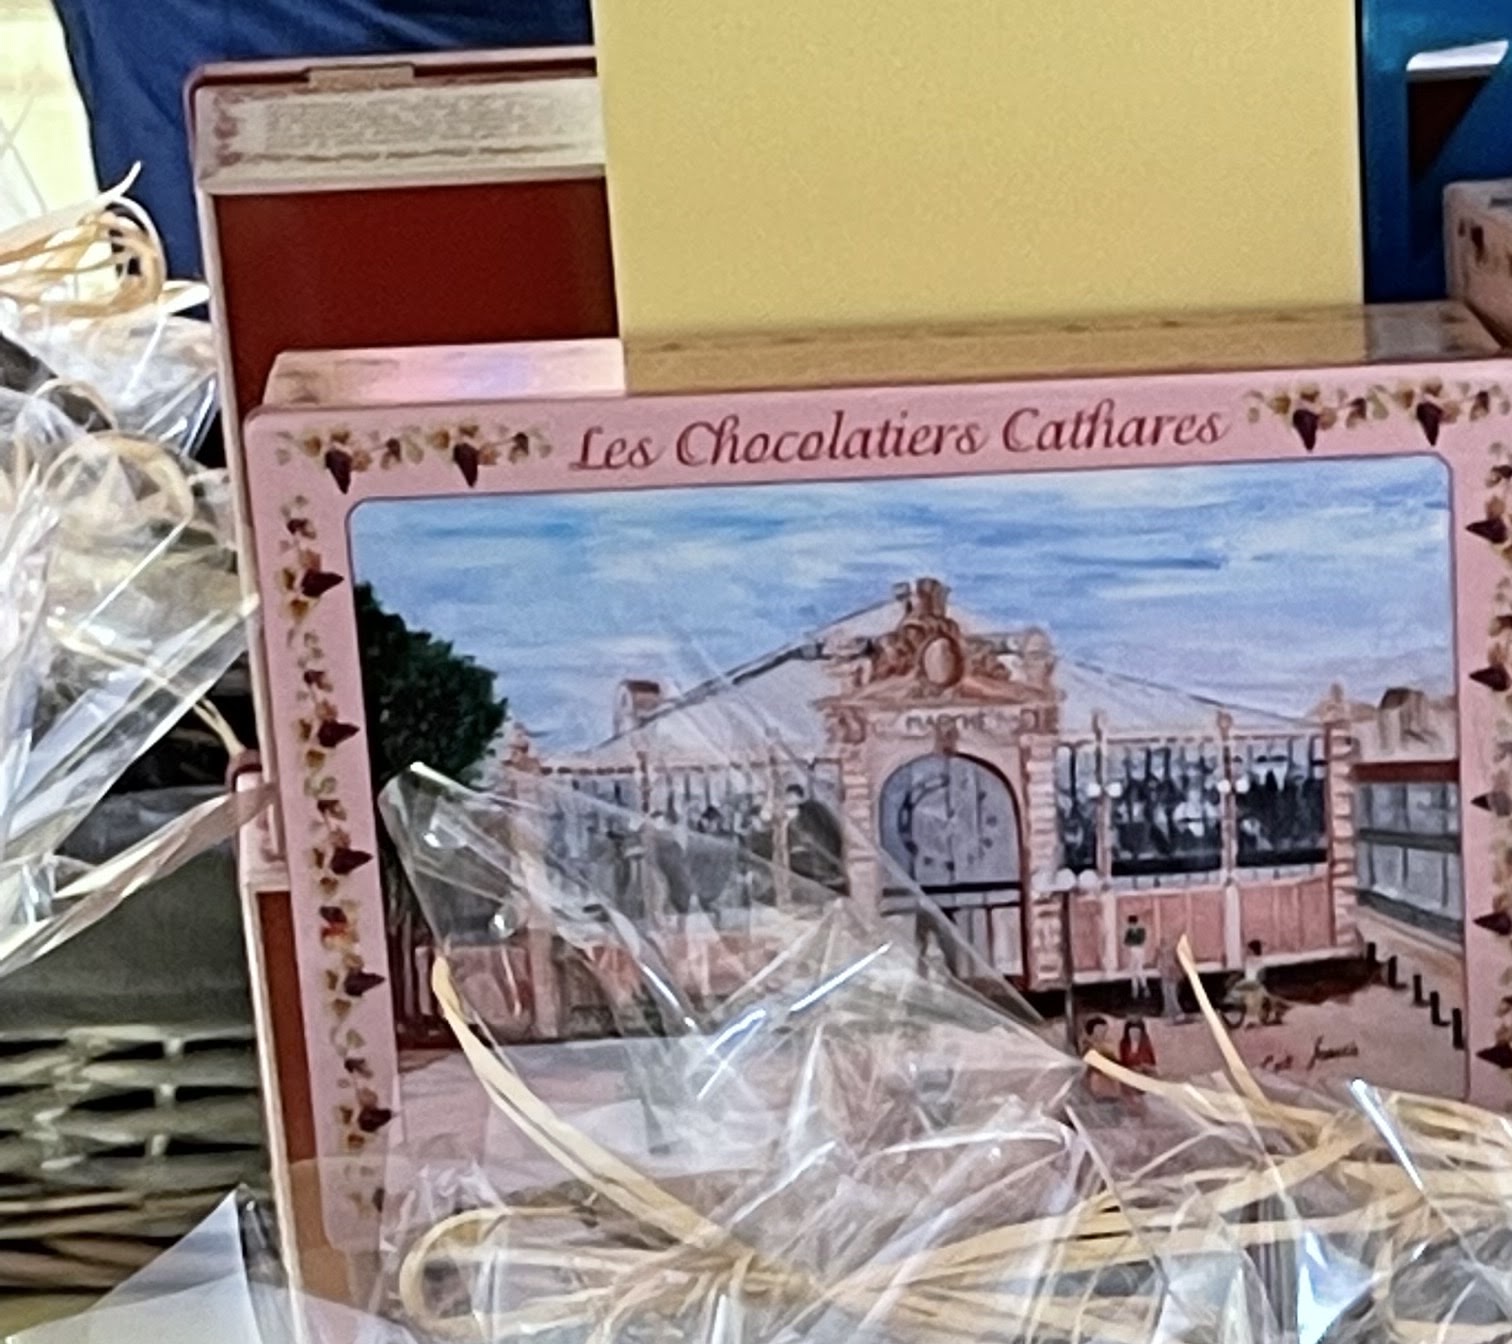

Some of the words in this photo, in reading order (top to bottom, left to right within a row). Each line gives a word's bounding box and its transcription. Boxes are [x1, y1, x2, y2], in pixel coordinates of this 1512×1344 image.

[568, 426, 662, 472] Les
[676, 409, 991, 467] Chocolatiers
[1002, 398, 1233, 453] Cathares
